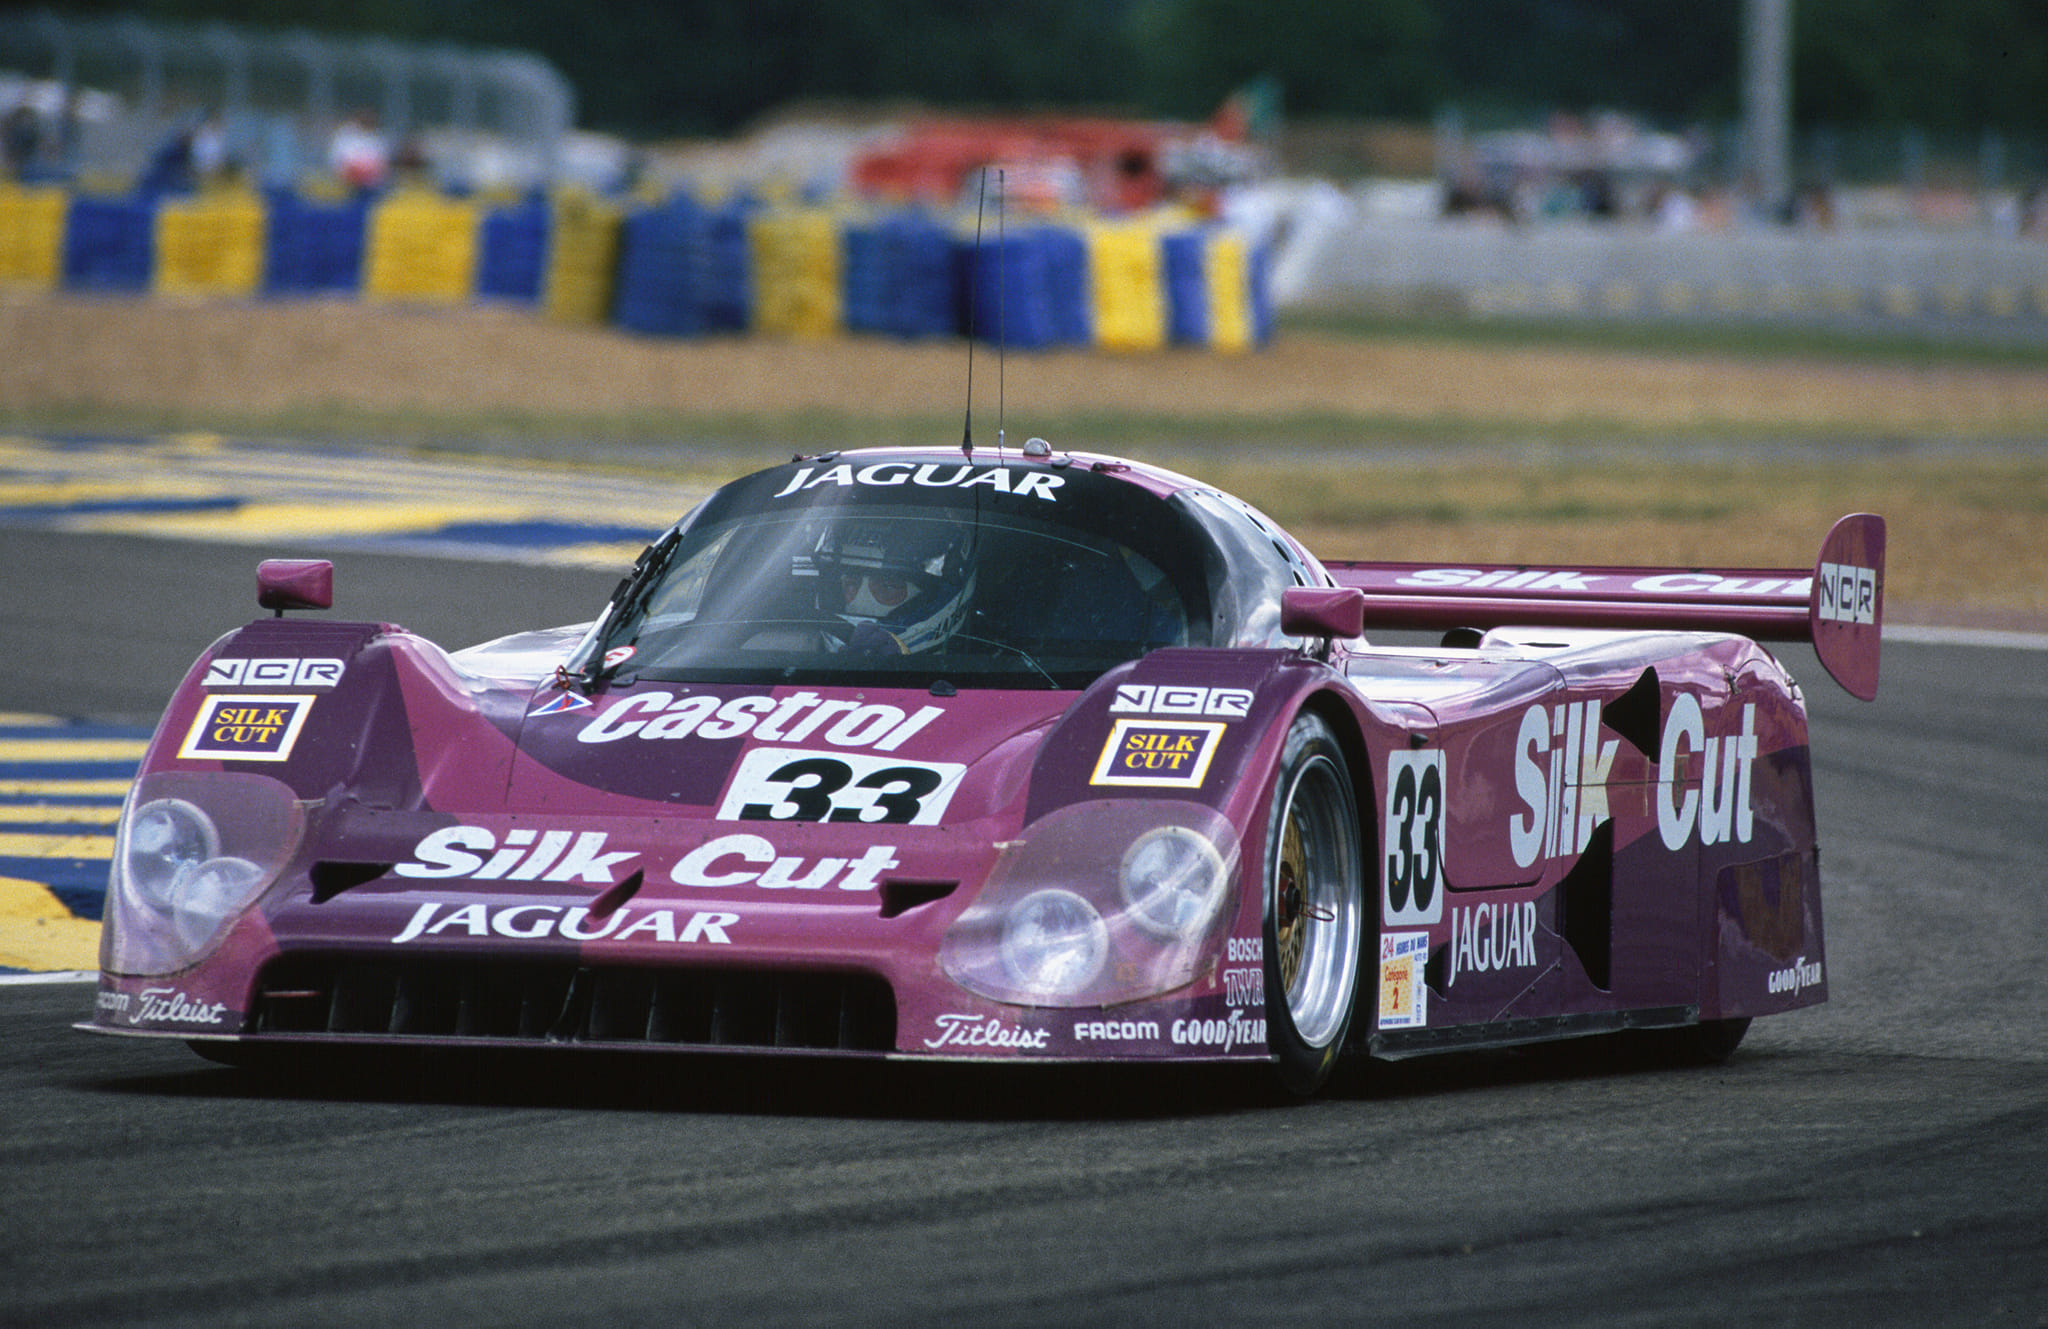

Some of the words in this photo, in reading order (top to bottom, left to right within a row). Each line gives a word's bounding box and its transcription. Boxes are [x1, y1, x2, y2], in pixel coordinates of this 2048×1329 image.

[774, 462, 1066, 502] JAGUAR
[1395, 568, 1607, 591] Silk
[1631, 573, 1814, 595] Cut
[1820, 571, 1873, 615] NCR
[205, 661, 342, 684] NCR
[214, 708, 289, 726] SILK
[1112, 687, 1252, 715] NCR
[212, 726, 279, 744] CUT
[576, 691, 946, 751] Castrol
[1124, 751, 1190, 769] CUT
[1125, 733, 1200, 752] SILK
[738, 757, 943, 825] 33
[1509, 698, 1621, 869] Silk
[1656, 691, 1759, 852] Cut
[1388, 763, 1442, 913] 33
[394, 825, 643, 883] Silk
[669, 833, 900, 891] Cut
[391, 902, 742, 945] JAGUAR
[1228, 937, 1263, 962] BOSCH
[1382, 936, 1394, 960] 24
[1447, 901, 1537, 988] JAGUAR
[1768, 955, 1822, 997] GOODYEAR
[129, 987, 227, 1024] Titleist
[1391, 986, 1399, 1009] 2
[923, 1014, 1051, 1048] Titleist
[1073, 1021, 1160, 1041] FACOM
[1171, 1008, 1267, 1054] GOODYEAR
